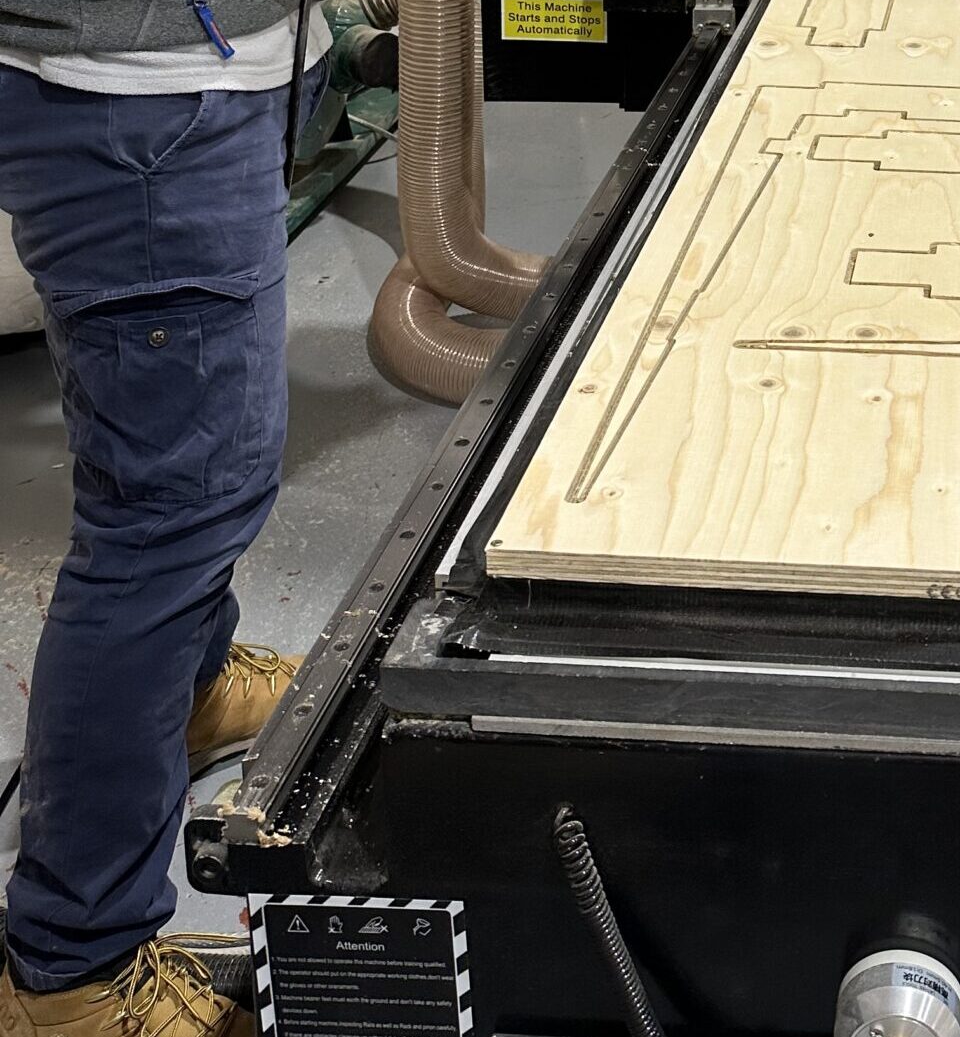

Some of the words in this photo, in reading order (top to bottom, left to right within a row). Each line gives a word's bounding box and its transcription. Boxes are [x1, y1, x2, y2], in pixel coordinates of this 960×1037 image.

[517, 1, 540, 10] This
[544, 2, 592, 12] Machine
[508, 12, 540, 22] Starts
[544, 14, 565, 24] and
[569, 15, 600, 26] Stops
[516, 24, 592, 38] Automatically
[336, 940, 386, 952] Attention
